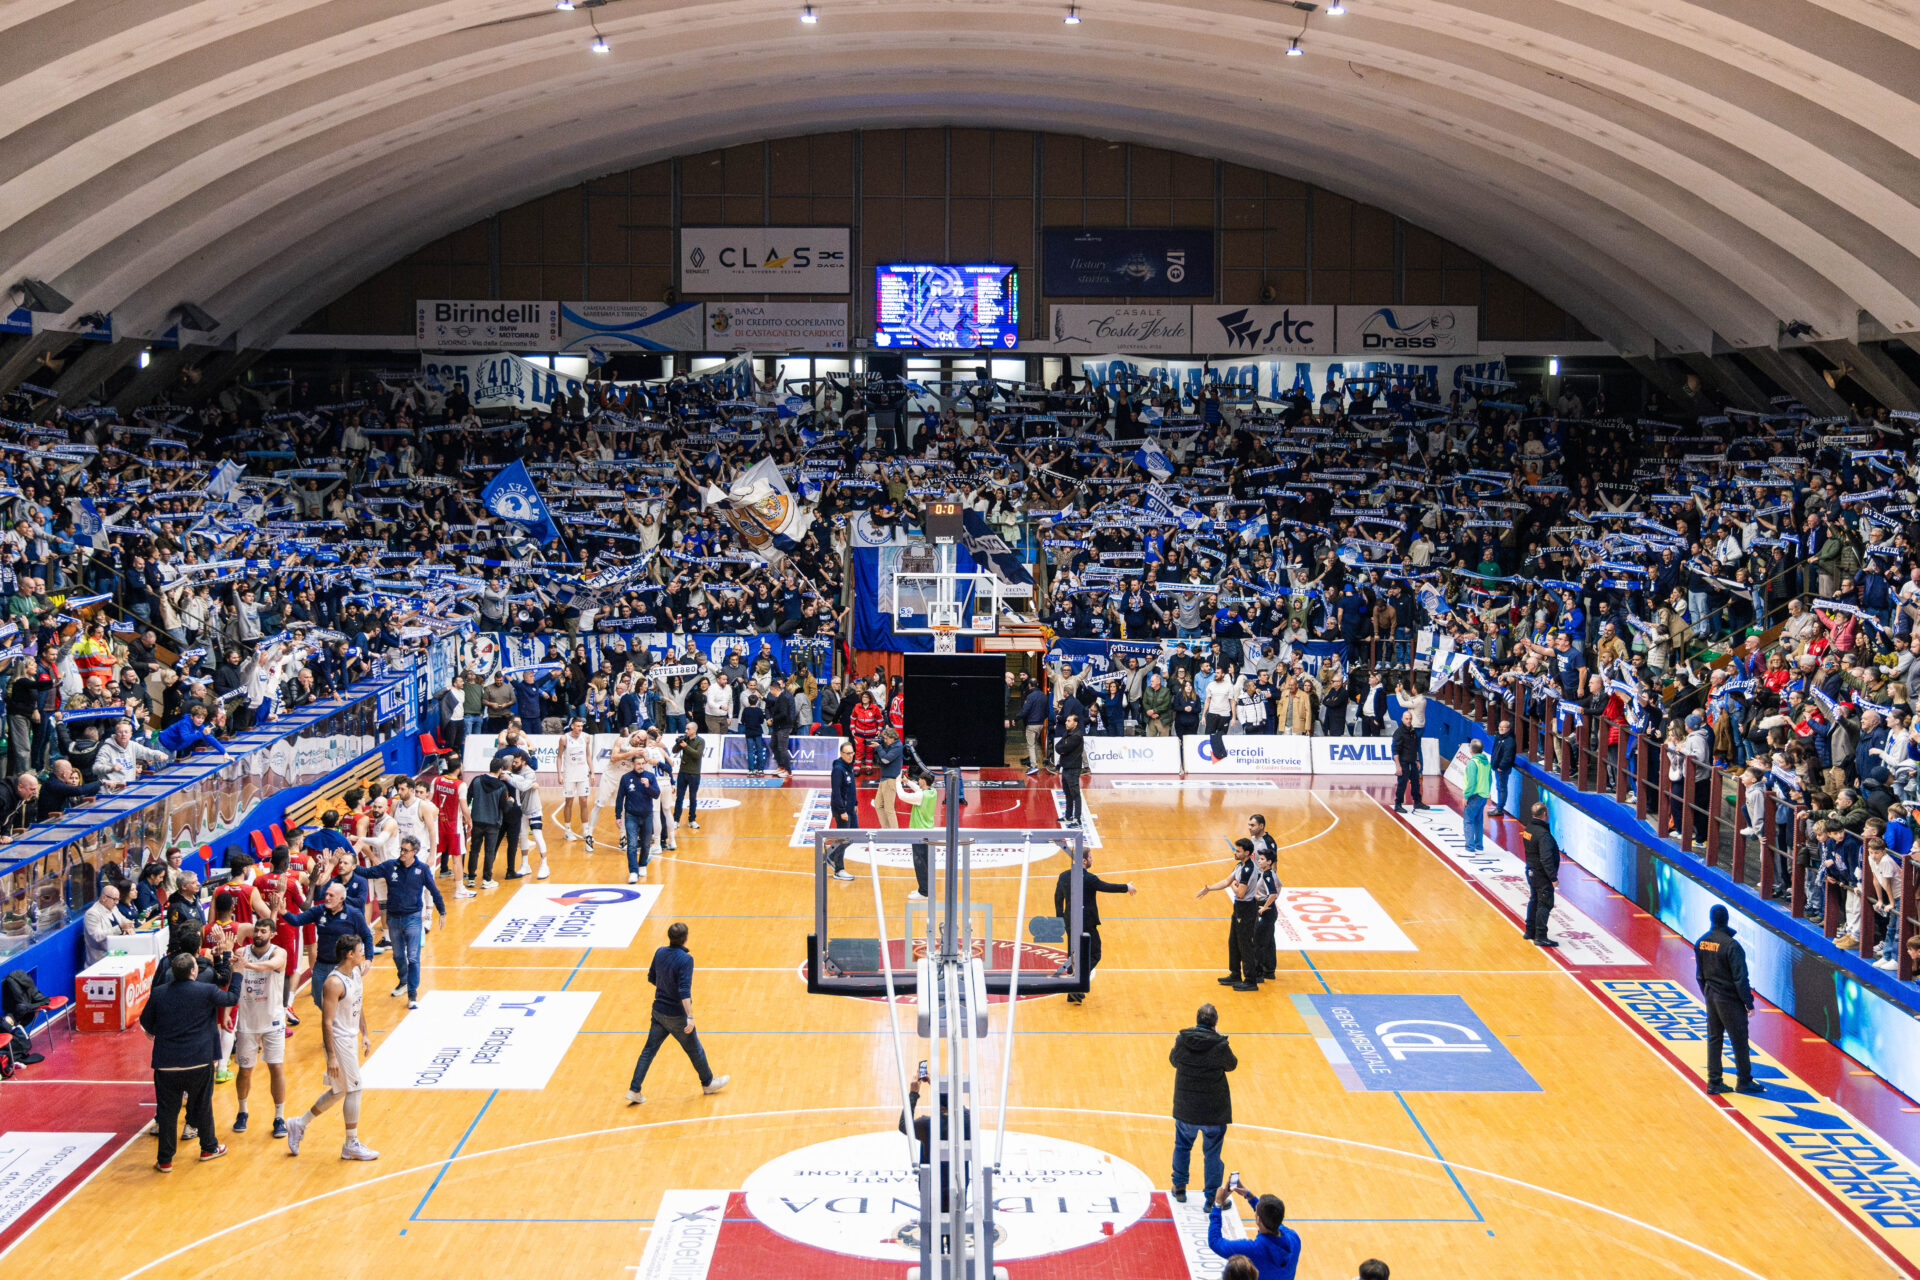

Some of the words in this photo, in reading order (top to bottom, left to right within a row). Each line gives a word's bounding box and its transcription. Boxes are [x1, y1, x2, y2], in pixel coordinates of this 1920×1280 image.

[719, 247, 810, 268] CLAS
[435, 303, 540, 323] Birindelli
[735, 308, 765, 316] BANCA
[735, 319, 743, 327] DI
[746, 319, 782, 327] CREDITO
[785, 319, 845, 327] COOPERATIVO
[735, 330, 743, 338] DI
[746, 330, 800, 338] CASTAGNETO
[803, 330, 844, 338] CARDUCCI
[1088, 316, 1138, 338] Costa
[1138, 317, 1186, 341] Verde
[1263, 308, 1314, 345] stc
[1363, 334, 1437, 348] Drass
[487, 358, 510, 387] 40
[480, 384, 519, 396] REBELS
[532, 367, 560, 405] LA
[935, 504, 954, 514] 0:0
[1113, 645, 1139, 654] PIELLE
[1142, 647, 1162, 656] 1960
[1236, 756, 1271, 765] impianti
[1271, 757, 1302, 766] service
[439, 794, 446, 808] 7
[553, 888, 641, 937] Quercioli
[1286, 894, 1368, 943] costa
[493, 918, 528, 943] service
[520, 916, 556, 943] impianti
[1699, 941, 1720, 952] SECURITY
[1602, 981, 1702, 1041] LIVORNO
[470, 1027, 515, 1064] randstad
[1345, 1029, 1391, 1074] AMBIENTALE
[1775, 1132, 1920, 1228] LIVORNO
